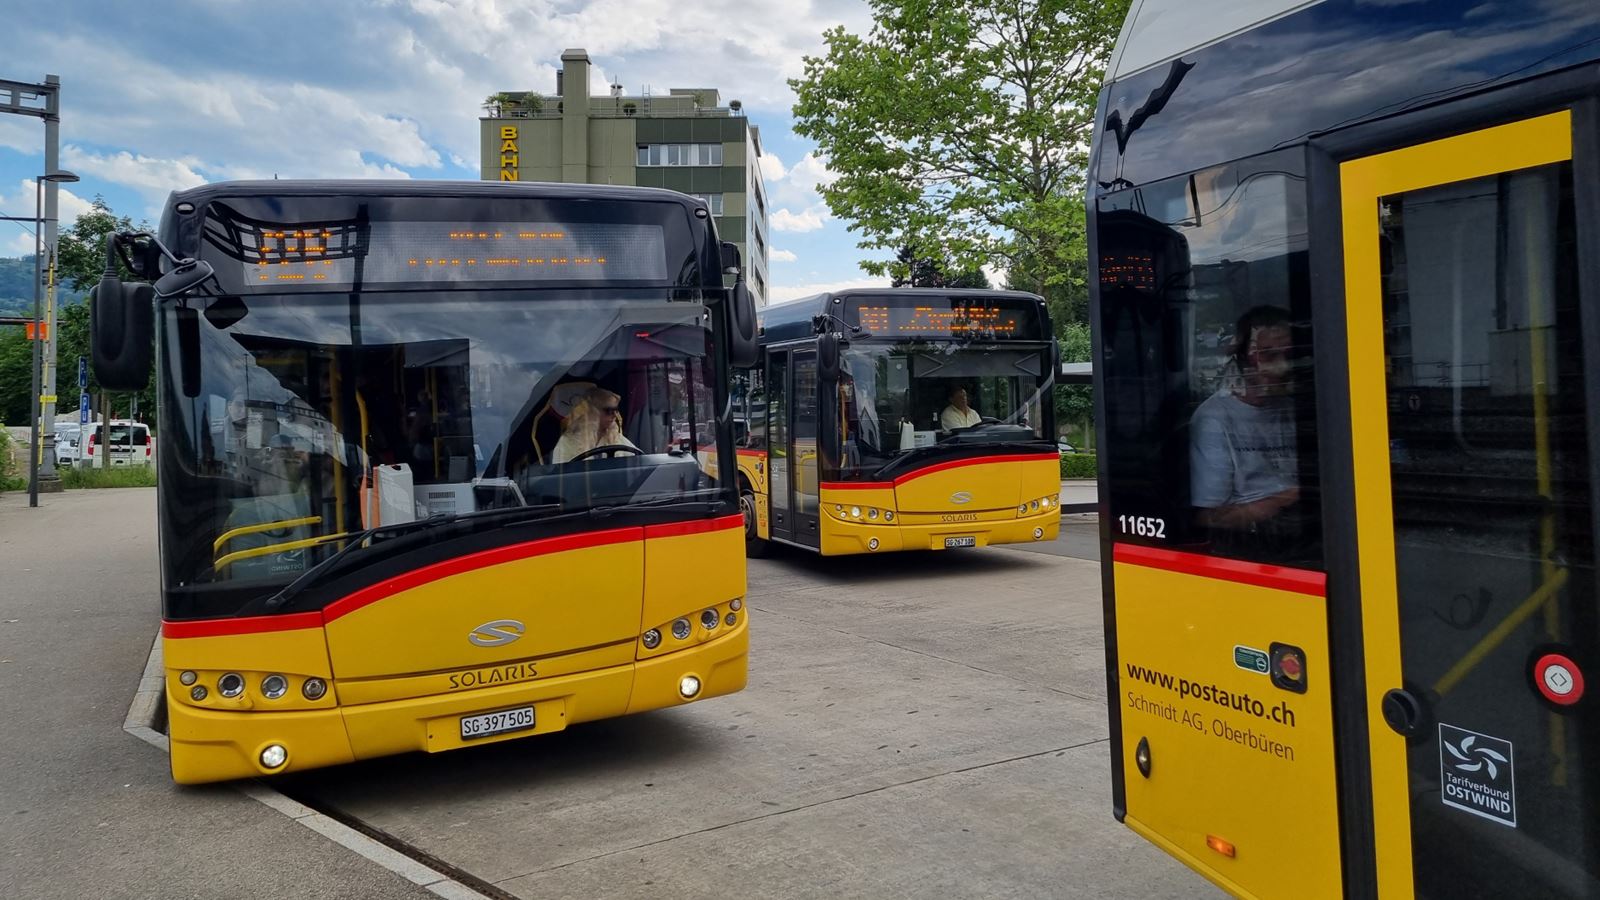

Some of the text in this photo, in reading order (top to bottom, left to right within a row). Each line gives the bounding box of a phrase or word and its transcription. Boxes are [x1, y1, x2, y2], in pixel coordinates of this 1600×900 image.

[501, 126, 518, 182] BAHN
[941, 513, 977, 521] SOLARIS
[1119, 515, 1166, 538] 11652
[449, 663, 538, 689] SOLARIS
[1127, 663, 1296, 727] www.postauto.ch
[1128, 692, 1294, 761] Schmidt AG, Oberbüren
[1446, 773, 1510, 800] Tarifverbund
[1446, 783, 1511, 813] OSTWIND
